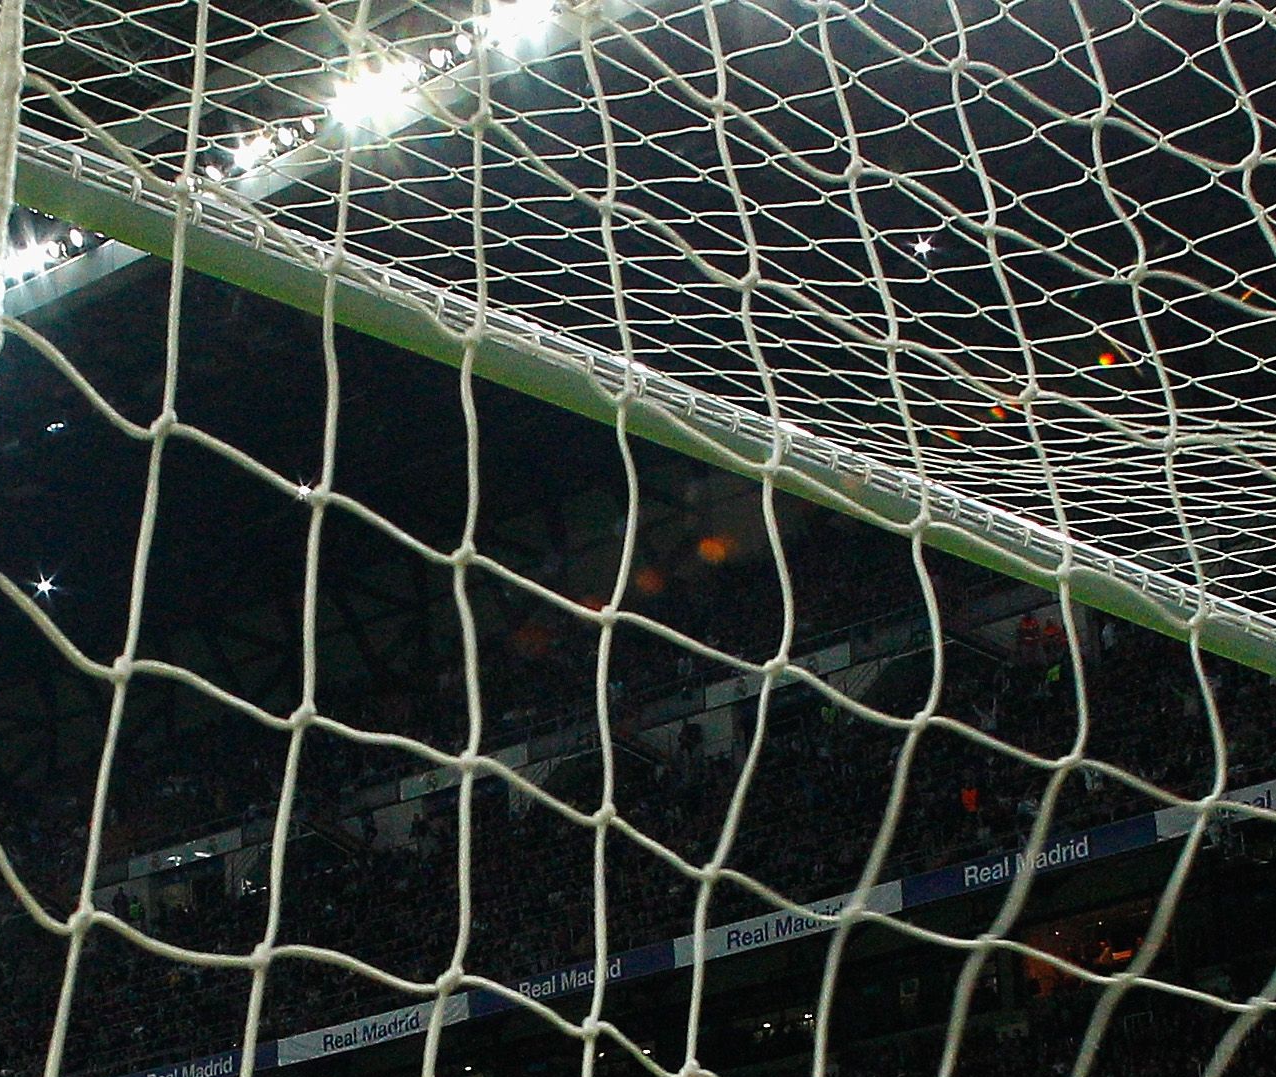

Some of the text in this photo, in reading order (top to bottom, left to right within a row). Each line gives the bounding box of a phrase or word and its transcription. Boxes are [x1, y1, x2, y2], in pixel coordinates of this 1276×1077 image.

[964, 857, 1009, 887] Real
[727, 926, 770, 949] Real
[518, 976, 556, 999] Real
[323, 1012, 420, 1051] Real Madrid
